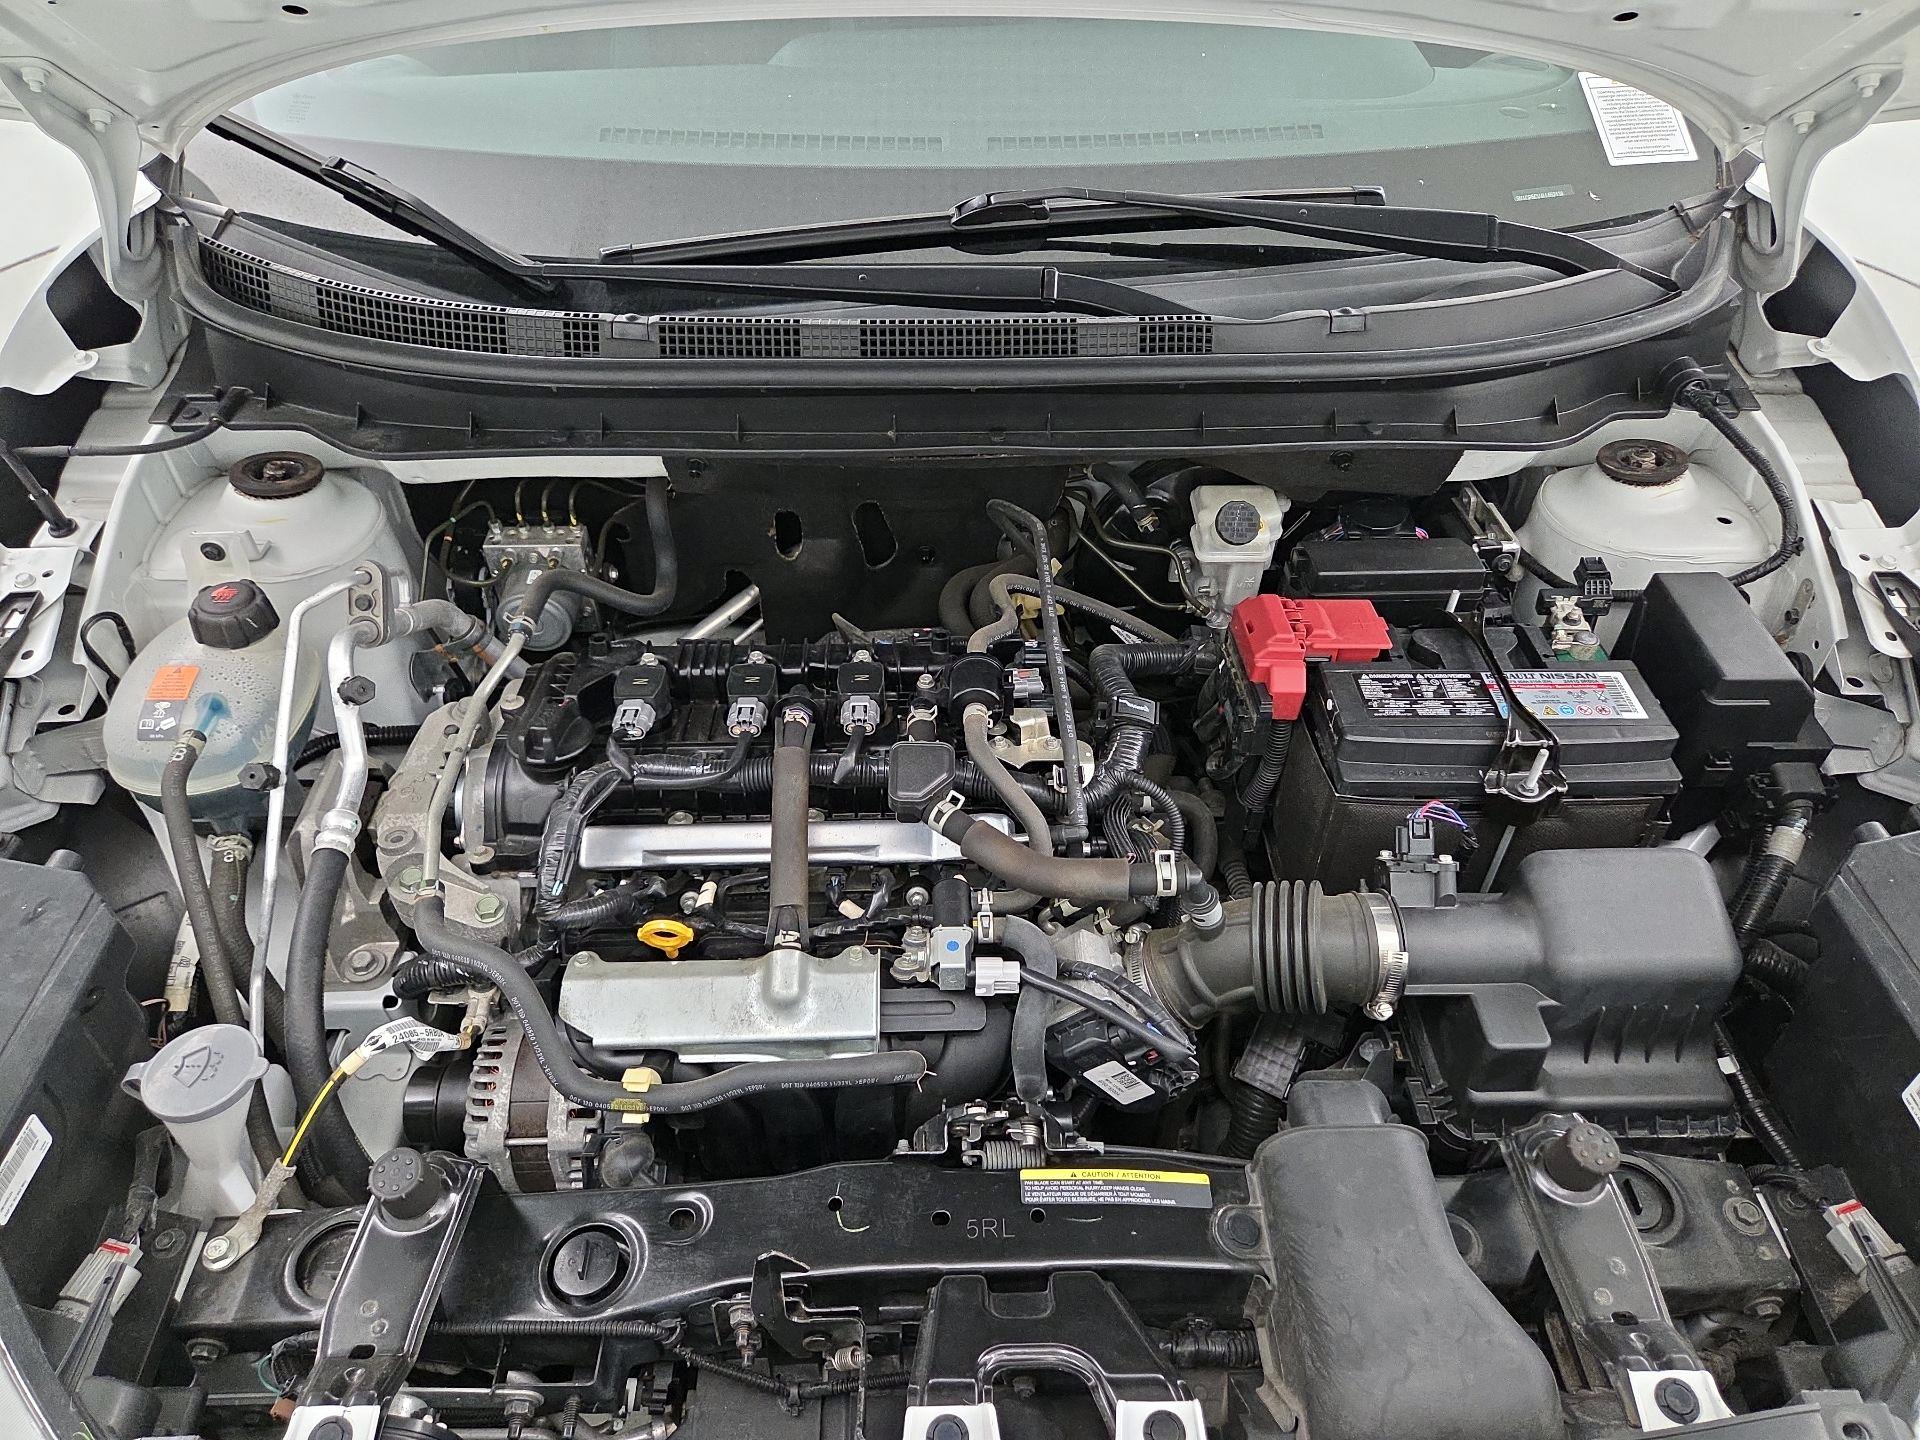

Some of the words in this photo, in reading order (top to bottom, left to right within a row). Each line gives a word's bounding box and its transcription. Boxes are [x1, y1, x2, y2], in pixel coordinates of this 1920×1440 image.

[1538, 672, 1598, 680] NISSAN
[1121, 1172, 1162, 1180] ATTENTION
[965, 1217, 1016, 1240] 5RL
